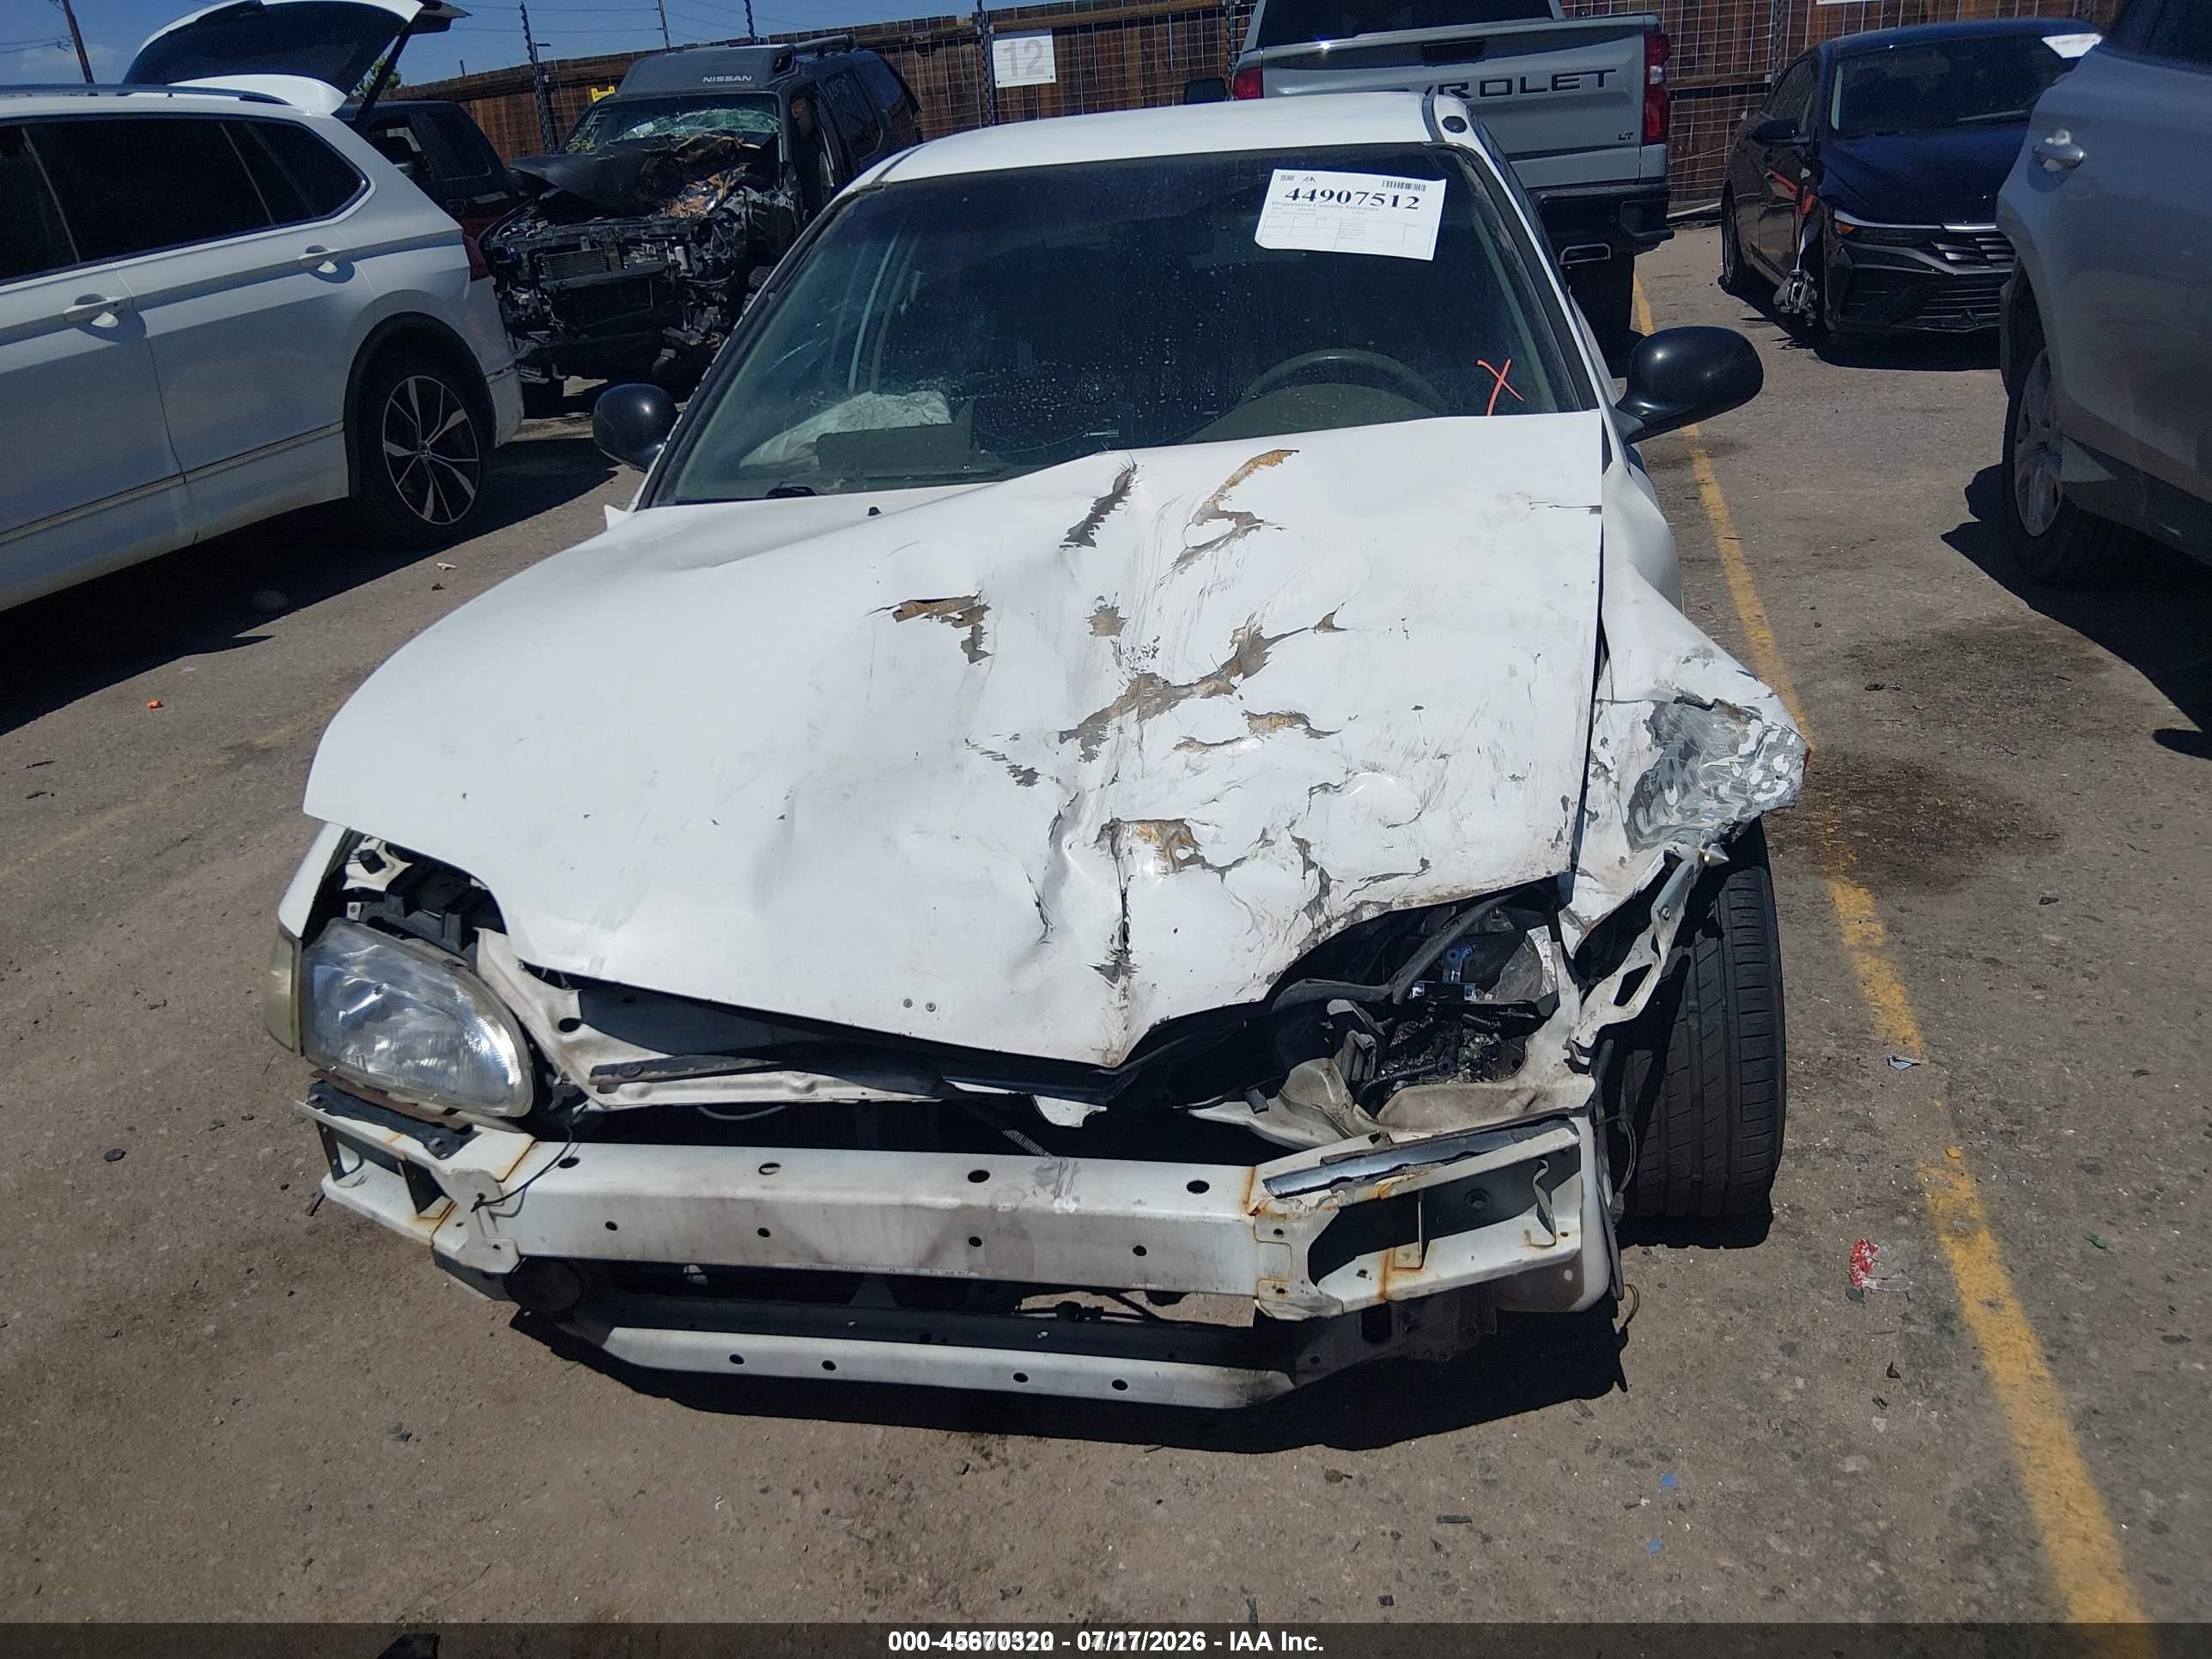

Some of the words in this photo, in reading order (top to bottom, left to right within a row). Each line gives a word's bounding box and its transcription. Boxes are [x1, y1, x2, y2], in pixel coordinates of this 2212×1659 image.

[1002, 39, 1046, 76] 12
[702, 75, 752, 83] NISSAN
[1425, 69, 1616, 99] ROLET
[1617, 131, 1634, 141] LT
[1285, 187, 1420, 210] 44907512
